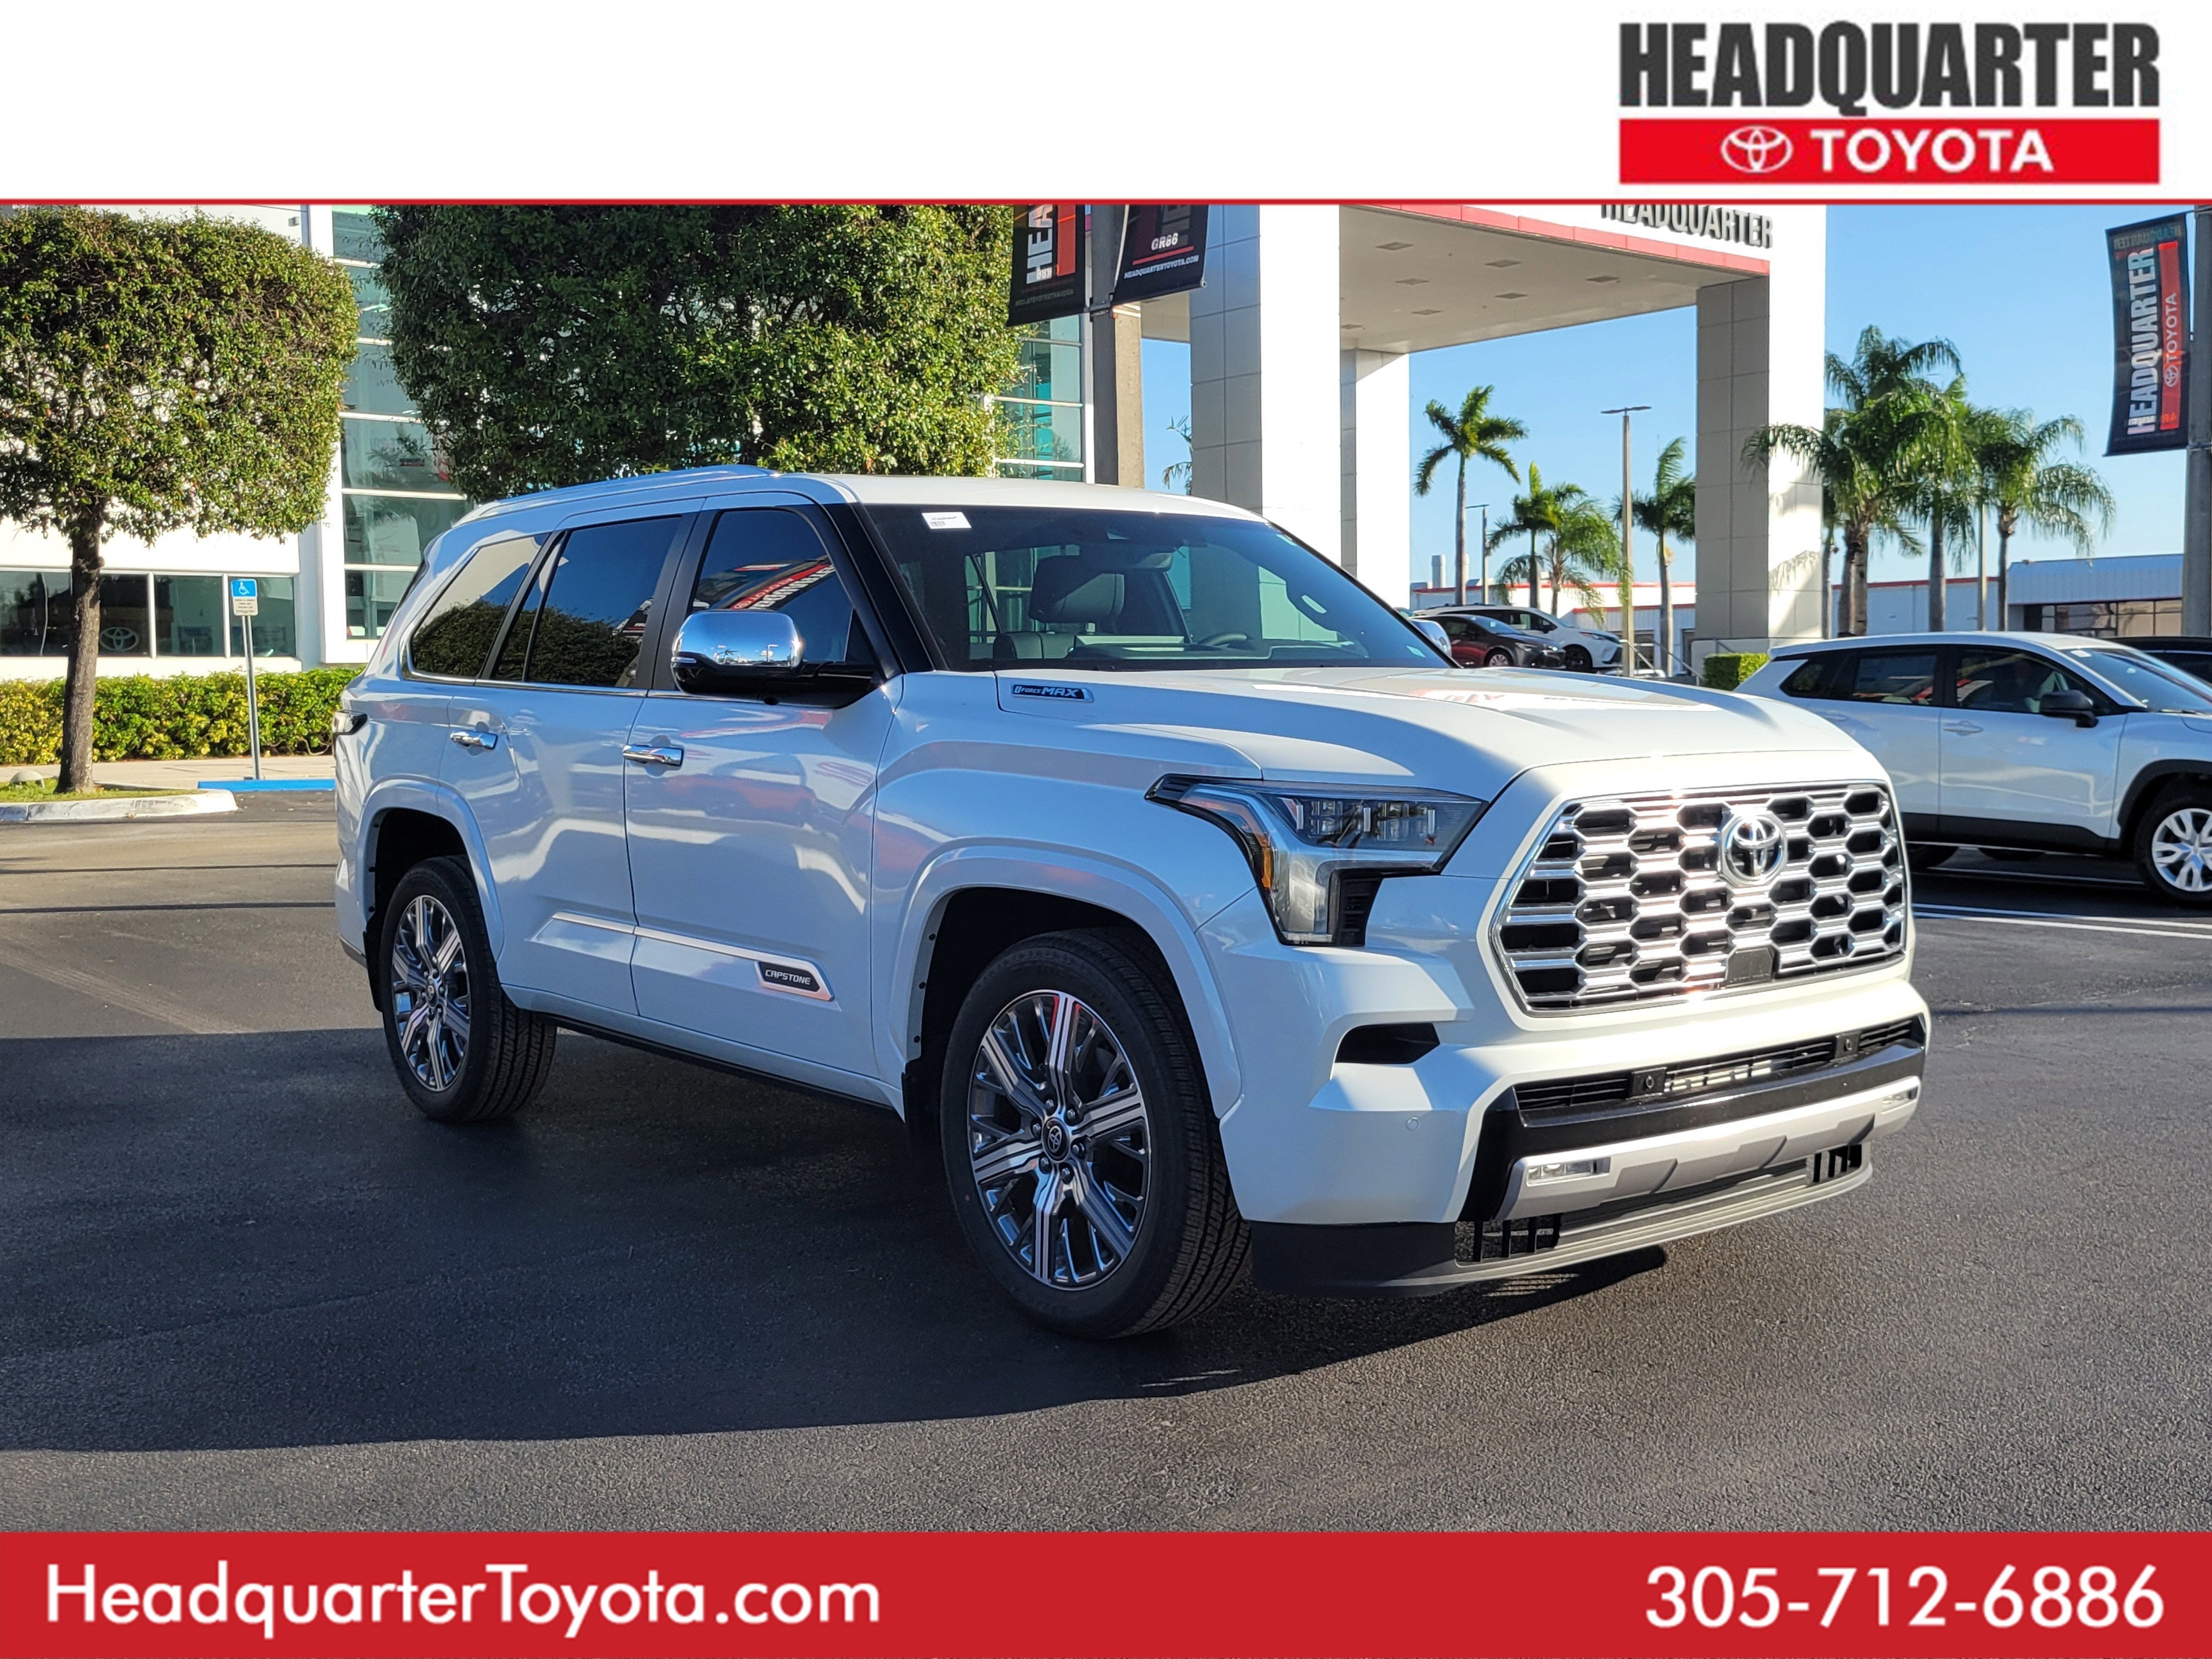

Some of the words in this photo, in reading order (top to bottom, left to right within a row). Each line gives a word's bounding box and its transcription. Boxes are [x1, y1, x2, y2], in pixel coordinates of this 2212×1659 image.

[1151, 233, 1178, 251] GR86
[1124, 255, 1199, 279] HEADQUARTERTOYOTA.COM
[2165, 291, 2179, 364] TOYOTA
[2127, 246, 2162, 435] HEADQUARTER
[1041, 687, 1079, 697] MAX
[765, 969, 811, 985] CAPSTONE
